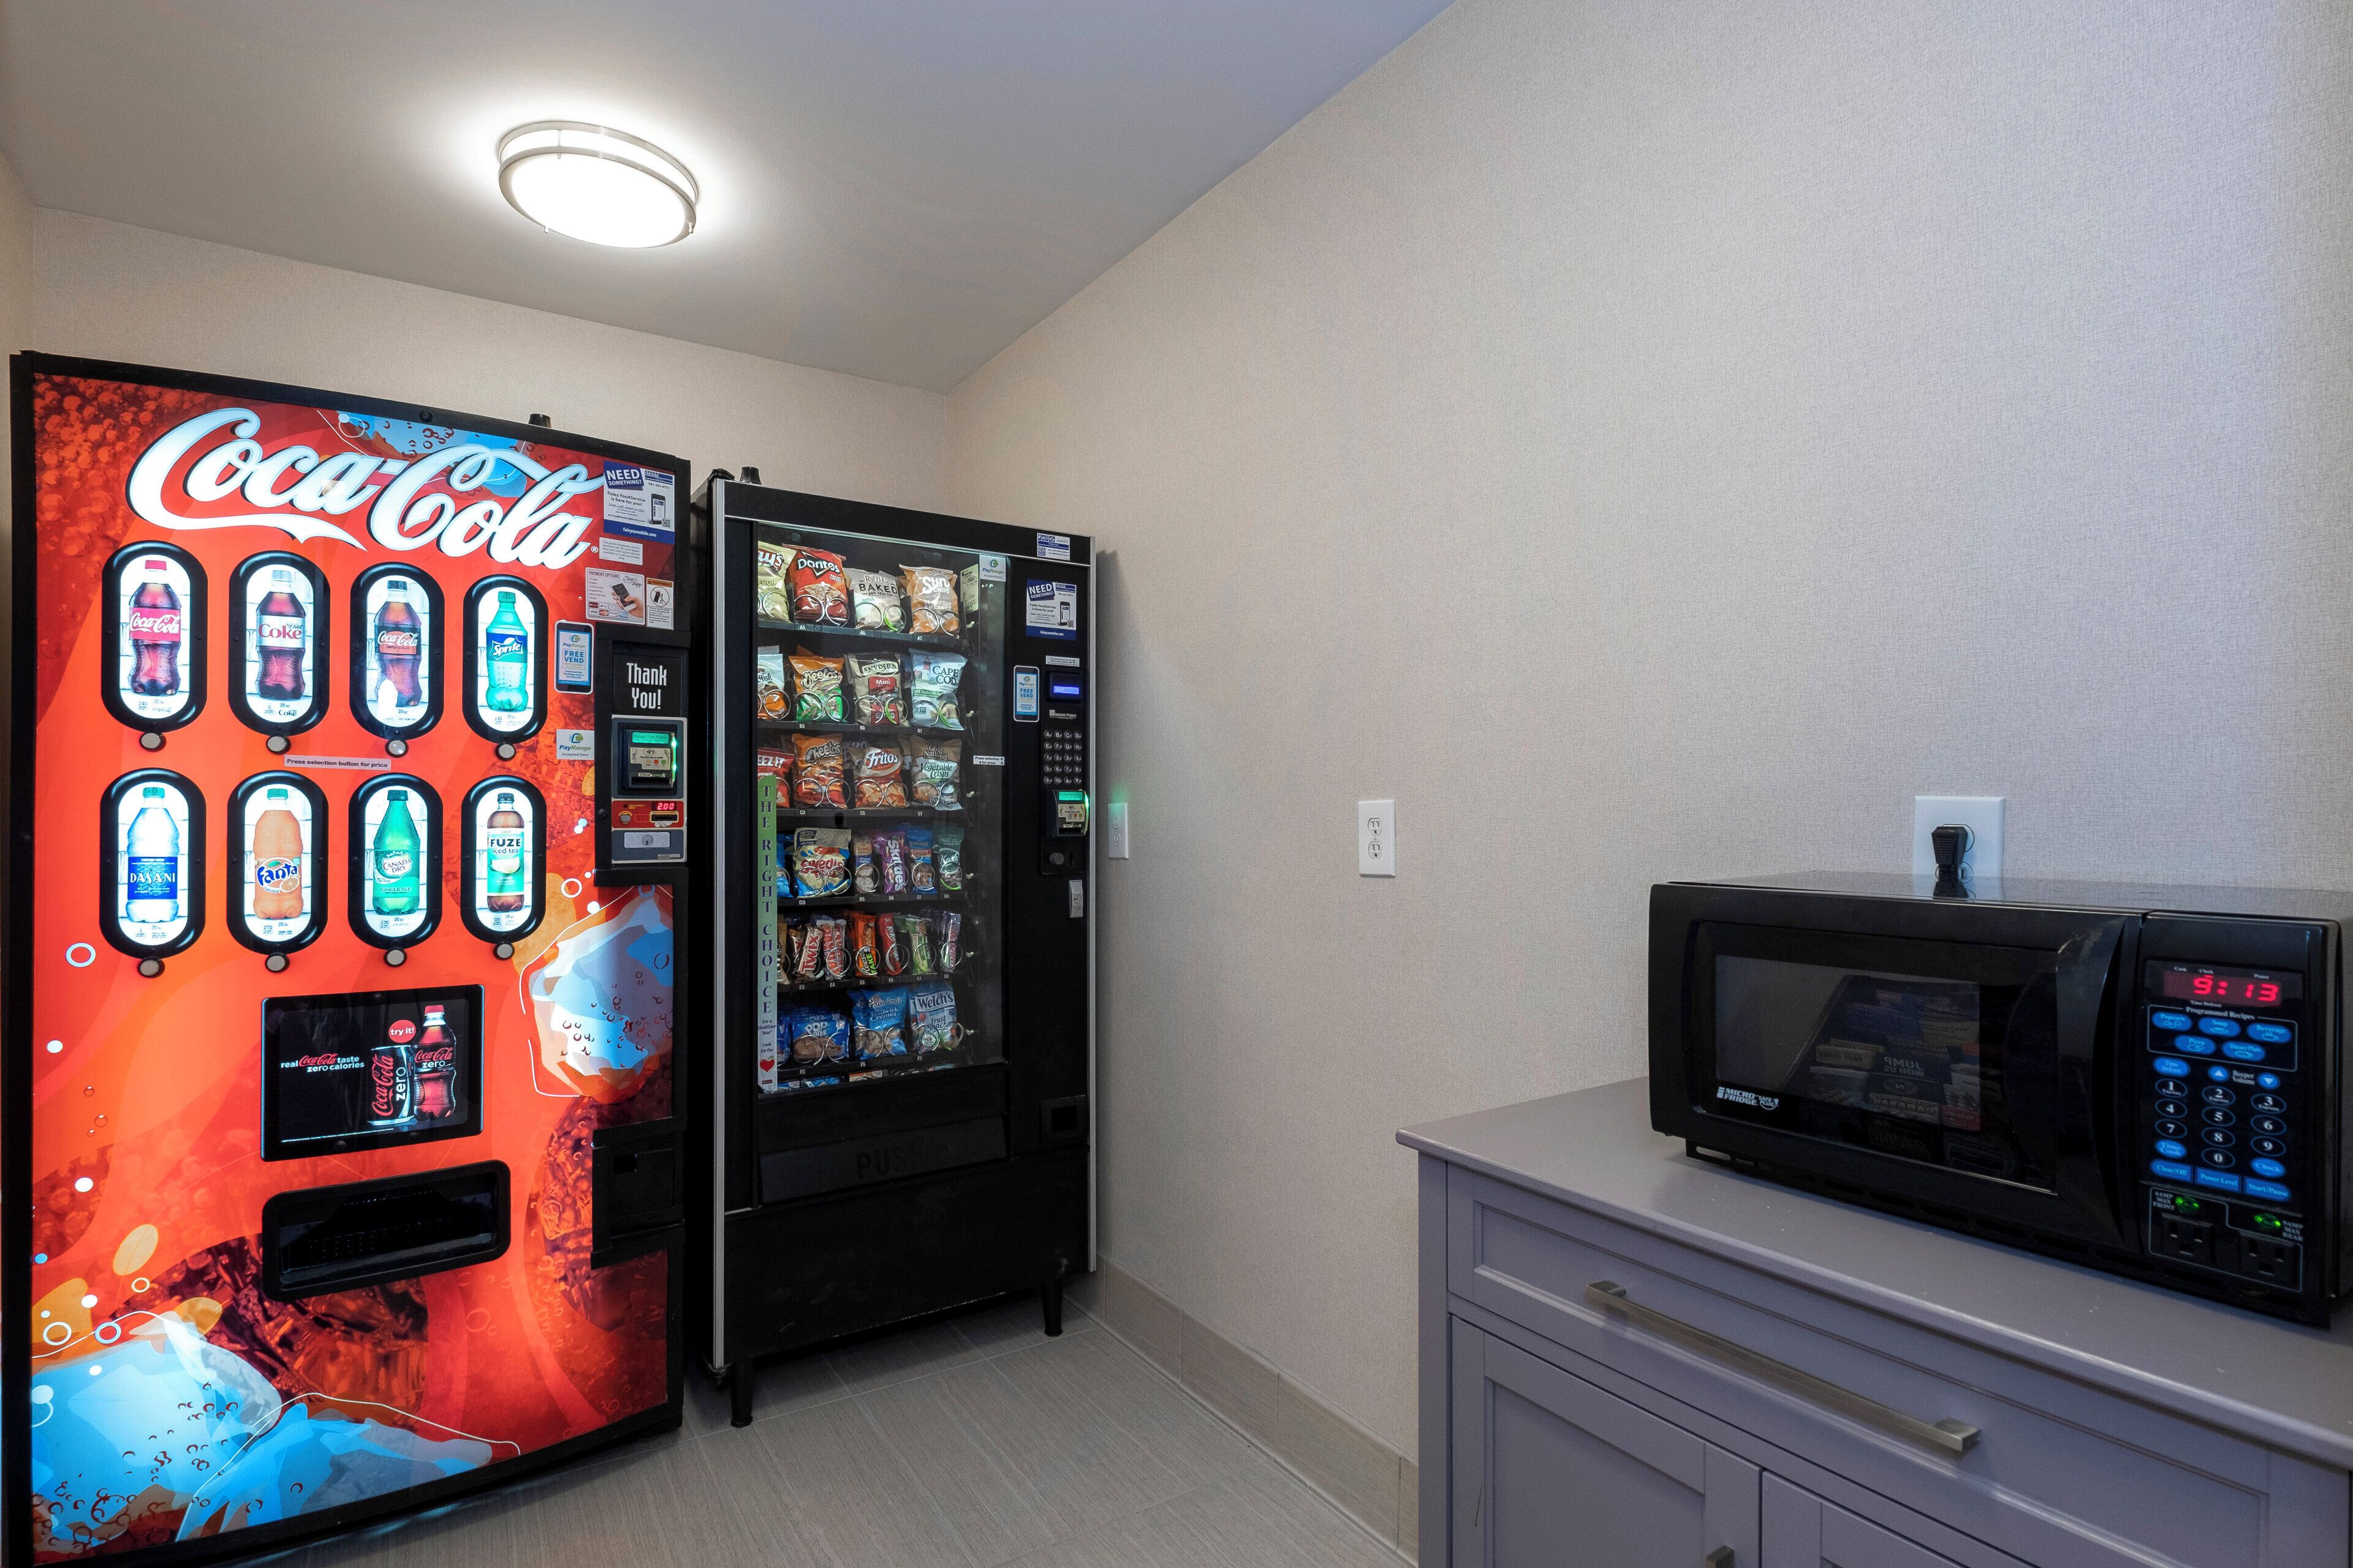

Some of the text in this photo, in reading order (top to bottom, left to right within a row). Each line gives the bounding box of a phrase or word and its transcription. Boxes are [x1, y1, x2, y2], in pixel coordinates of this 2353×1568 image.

[606, 469, 640, 480] NEED
[126, 407, 604, 569] Coca-Cola
[797, 558, 840, 573] Doritos
[858, 583, 898, 594] BAKED
[922, 577, 950, 594] Sun
[1029, 583, 1053, 594] NEED
[130, 612, 181, 634] Coca-Cola
[259, 623, 303, 639] Coke
[377, 631, 419, 647] Coca-Cola
[493, 642, 521, 656] Sprite
[863, 662, 896, 673] SNYDER'S
[933, 665, 960, 678] CAPE
[627, 662, 667, 686] Thank
[936, 675, 957, 686] COD
[632, 687, 661, 710] You!
[805, 741, 842, 763] Cheetos
[924, 750, 947, 760] Natured
[866, 750, 898, 770] Fritos
[921, 762, 953, 772] Vegetable
[930, 770, 949, 779] Crisps
[761, 786, 773, 828] THE
[383, 859, 412, 870] CANADA
[131, 869, 175, 886] DASANI
[257, 863, 298, 886] Fanta
[762, 839, 773, 914] RIGHT
[800, 934, 820, 974] TWIX
[762, 923, 773, 1014] CHOICE
[866, 953, 876, 974] TAKE
[2194, 977, 2279, 1002] 9:13
[917, 994, 954, 1009] Welch's
[871, 1007, 898, 1017] Sandwich
[871, 1012, 897, 1021] Cremes
[2186, 1007, 2255, 1020] Programmed Recipes
[931, 1015, 947, 1025] Fruit
[2257, 1025, 2286, 1034] Beverage
[299, 1053, 338, 1067] Coca-Cola
[415, 1047, 453, 1063] Coca-Cola
[329, 1061, 365, 1070] calories
[422, 1061, 445, 1069] zero
[2233, 1070, 2254, 1079] Beeper
[371, 1053, 394, 1116] Coca-Cola
[396, 1067, 406, 1101] zero
[2169, 1081, 2174, 1091] 1
[2232, 1076, 2256, 1085] Volume
[1725, 1088, 1756, 1099] MICRO
[2215, 1089, 2223, 1099] 2
[1724, 1094, 1758, 1105] FRIDGE
[2264, 1096, 2273, 1107] 3
[2166, 1104, 2174, 1113] 4
[2214, 1112, 2223, 1122] 5
[2167, 1124, 2175, 1133] 7
[2264, 1121, 2273, 1131] 6
[2215, 1132, 2223, 1142] 8
[2264, 1141, 2273, 1151] 9
[2161, 1148, 2181, 1156] Cook
[2214, 1153, 2222, 1163] 0
[2157, 1165, 2187, 1176] Clear/Off
[2255, 1162, 2281, 1173] Clock
[2200, 1173, 2238, 1186] Power Level
[2249, 1183, 2289, 1197] Start/Pause
[2284, 1227, 2300, 1235] MAX
[2283, 1232, 2303, 1242] REAR
